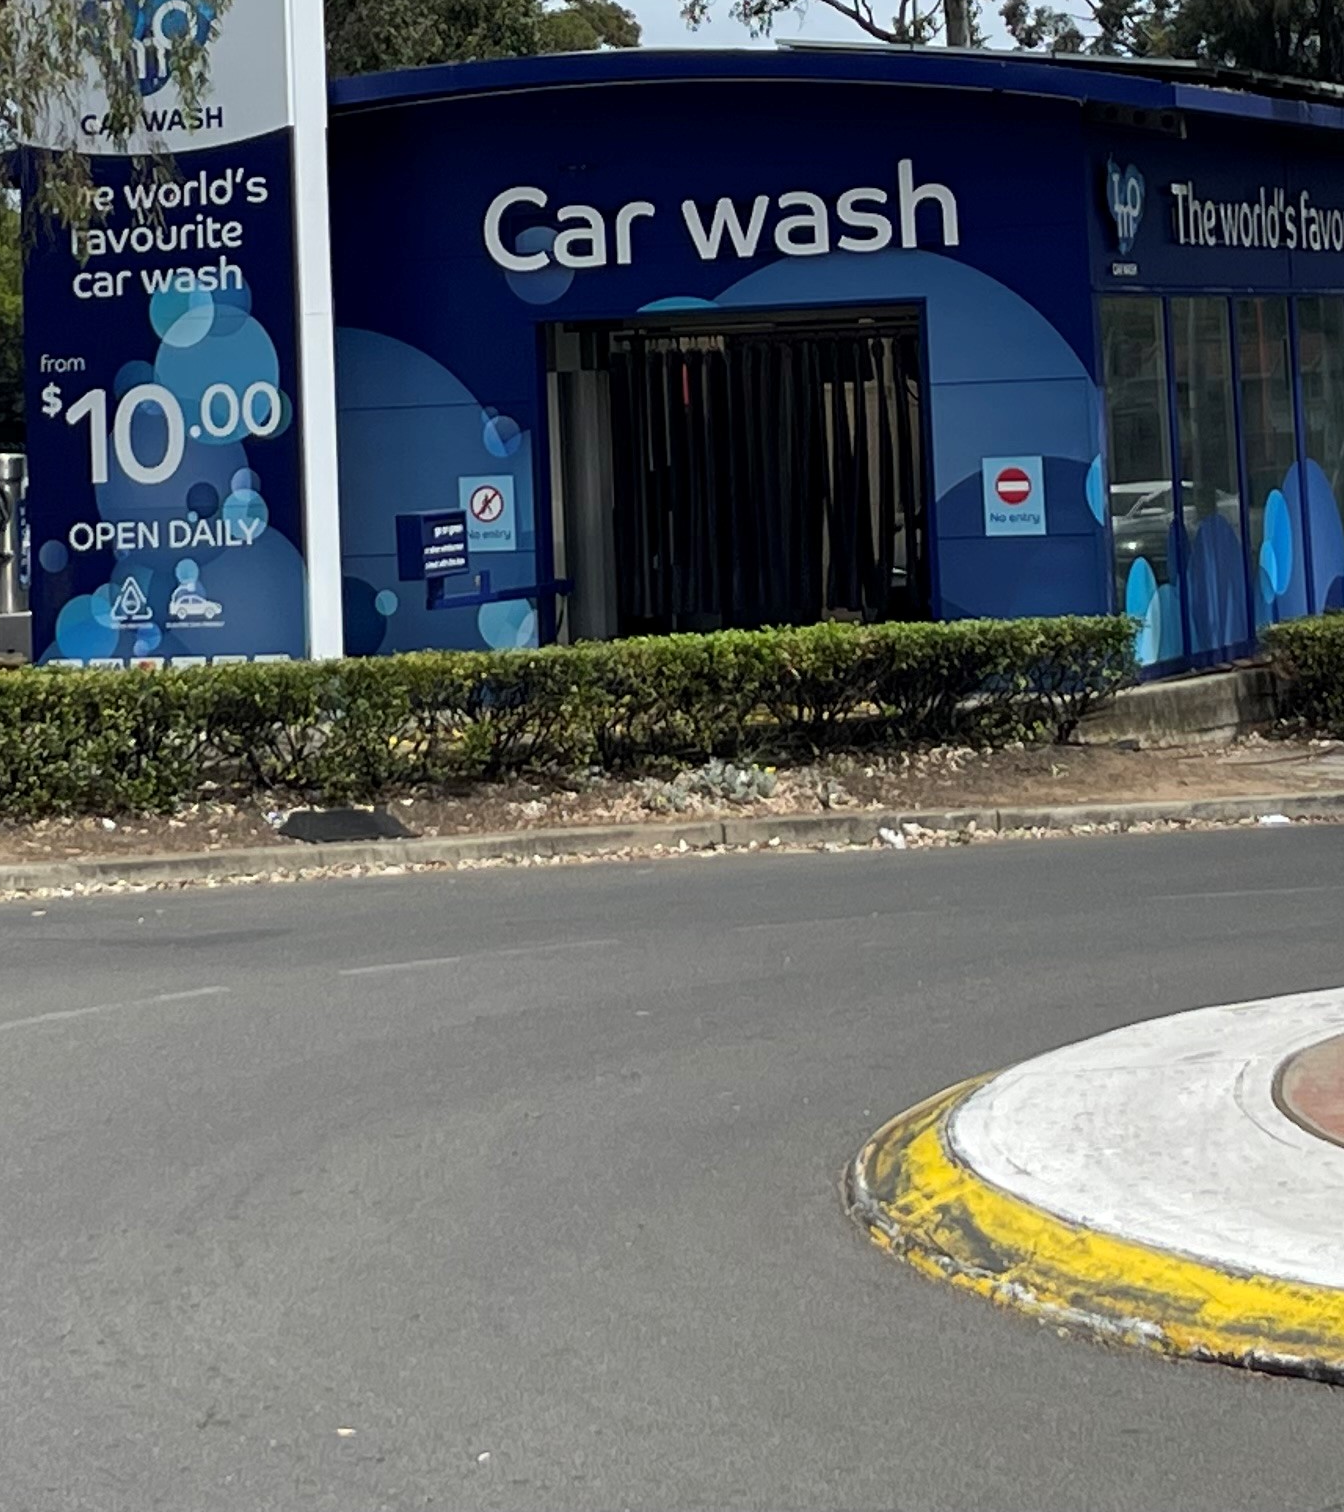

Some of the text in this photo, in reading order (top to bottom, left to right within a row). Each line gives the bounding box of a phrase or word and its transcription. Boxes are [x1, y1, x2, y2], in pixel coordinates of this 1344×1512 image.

[81, 106, 223, 136] CA WASH
[124, 168, 268, 210] world's
[484, 158, 960, 272] Car wash
[1170, 180, 1216, 246] The
[1220, 186, 1297, 250] world's
[72, 255, 244, 299] car wash
[40, 354, 86, 373] from
[69, 517, 260, 551] OPEN DAILY
[989, 512, 1041, 525] No entry
